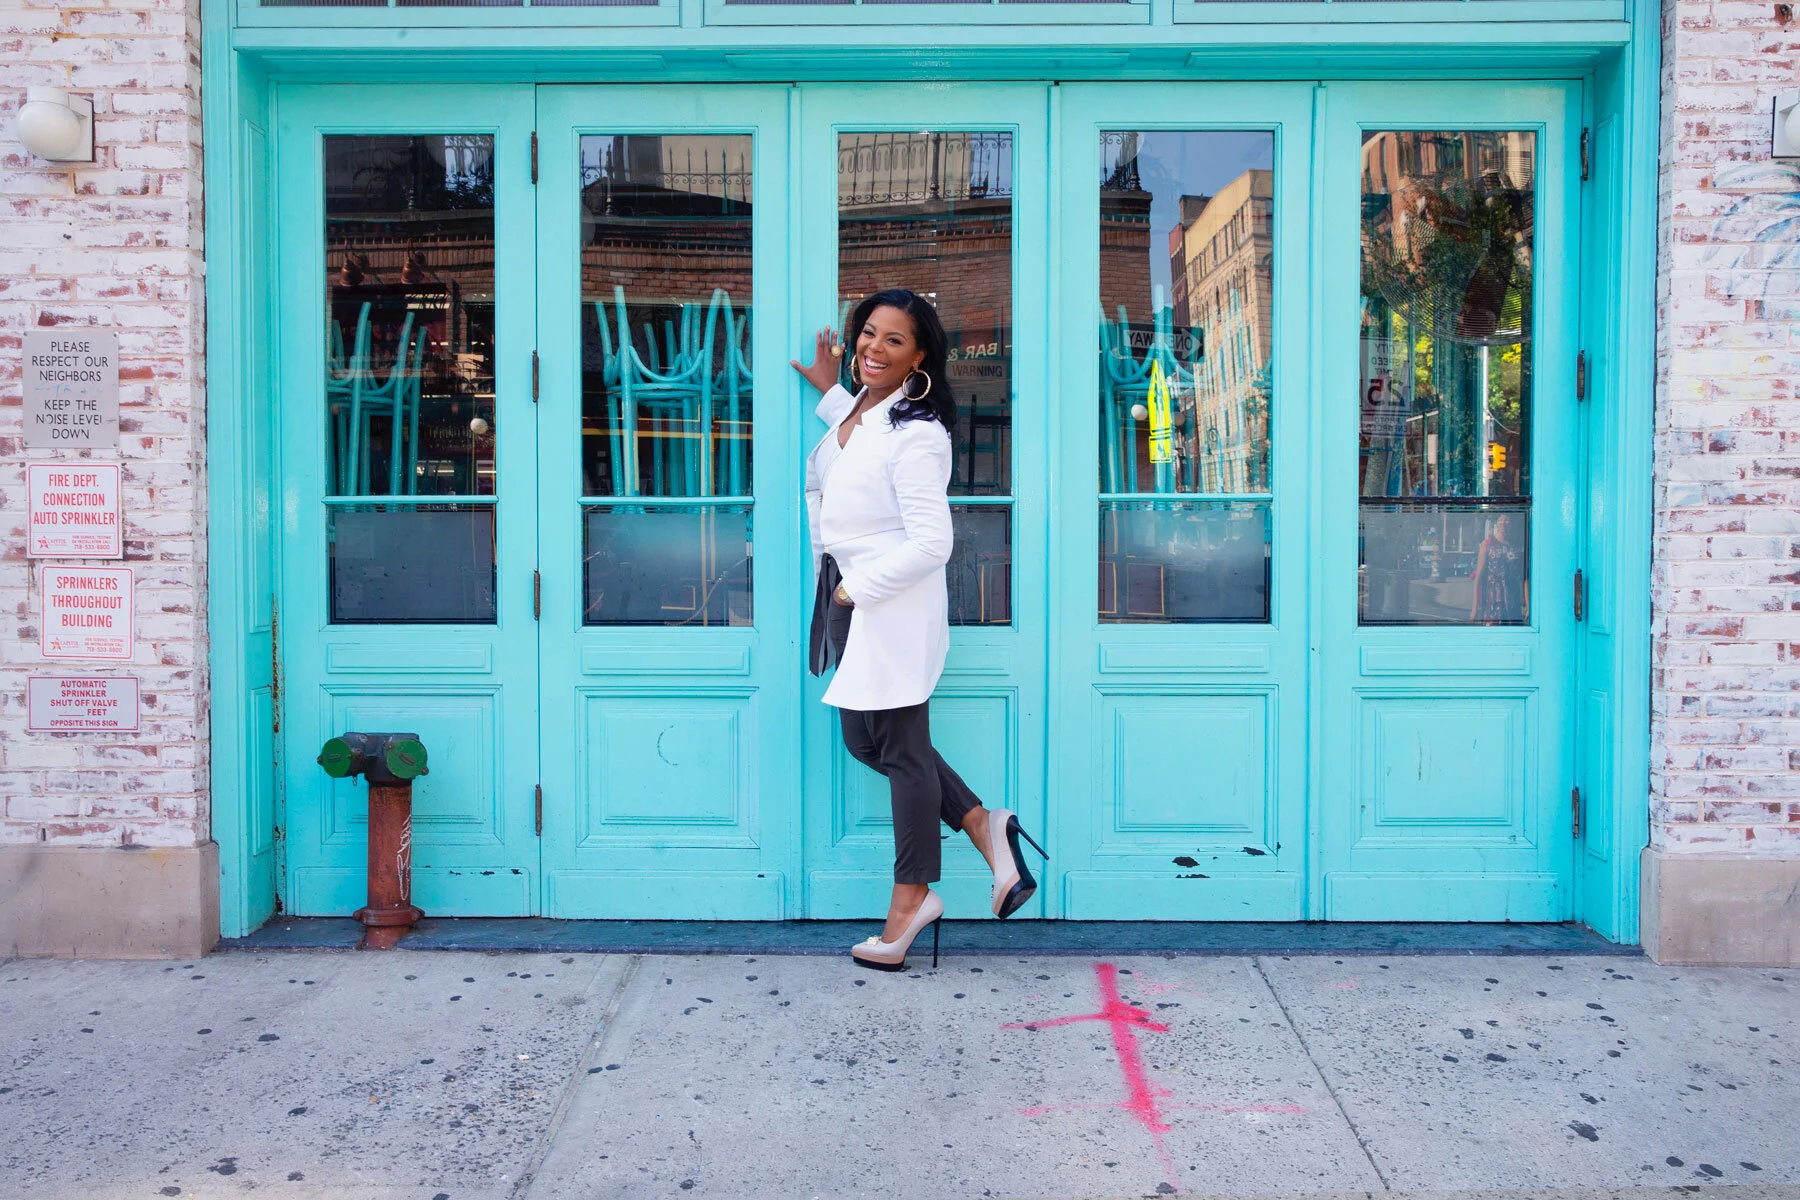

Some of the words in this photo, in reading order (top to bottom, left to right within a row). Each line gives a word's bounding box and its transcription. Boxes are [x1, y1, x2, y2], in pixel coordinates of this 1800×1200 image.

[51, 341, 90, 352] PLEASE
[31, 355, 79, 367] RESPECT
[84, 356, 109, 367] OUR
[39, 370, 102, 382] NEIGHBORS
[952, 364, 1003, 378] WARNING
[44, 399, 71, 411] KEEP
[75, 399, 98, 411] THE
[35, 413, 69, 425] NOISE
[51, 428, 90, 440] DOWN
[48, 473, 70, 487] FIRE
[73, 474, 99, 488] DEPT.
[43, 492, 106, 506] CONNECTION
[33, 511, 58, 525] AUTO
[61, 511, 115, 525] SPRINKLER
[56, 576, 118, 590] SPRINKLERS
[51, 594, 123, 609] THROUGHOUT
[61, 613, 113, 628] BUILDING
[60, 680, 107, 688] AUTOMATIC
[61, 689, 107, 698] SPRINKLER
[50, 699, 73, 707] SHUT
[74, 699, 90, 707] OFF
[92, 699, 118, 707] VALVE
[87, 708, 108, 716] FEET
[50, 719, 84, 727] OPPOSITE
[85, 719, 101, 727] THIS
[101, 719, 118, 727] SIGN
